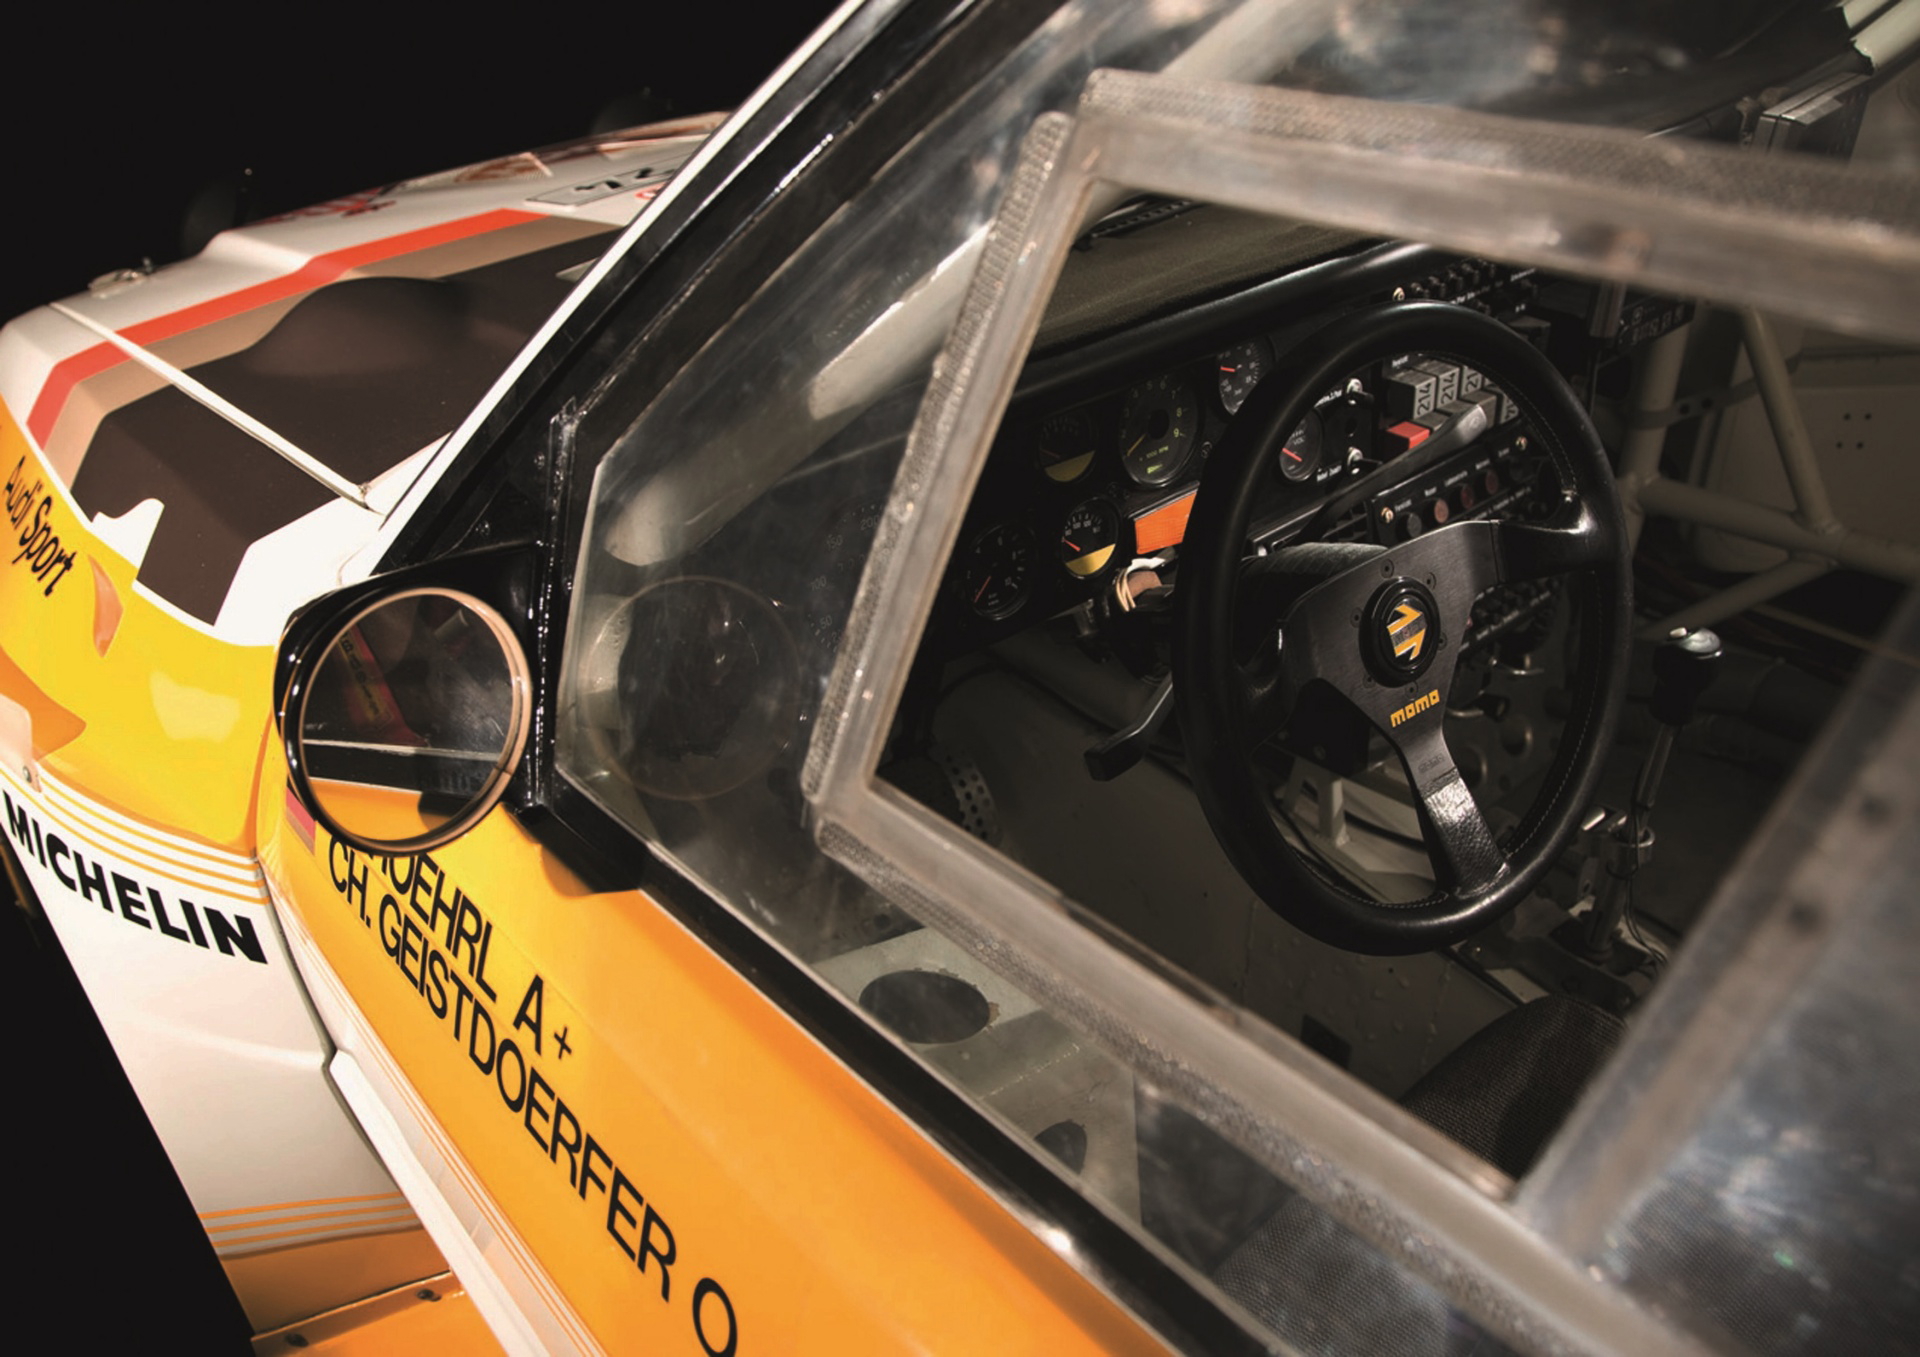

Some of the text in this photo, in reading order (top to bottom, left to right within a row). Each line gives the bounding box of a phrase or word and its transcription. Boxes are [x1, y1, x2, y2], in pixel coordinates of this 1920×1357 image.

[1417, 382, 1431, 416] 214
[1441, 373, 1456, 405] 214
[1466, 372, 1479, 392] 21
[3, 455, 77, 597] Audi Sport
[1390, 689, 1440, 728] momo
[3, 789, 268, 965] MICHELIN
[328, 835, 371, 929] CH.
[379, 893, 676, 1303] GEISTDOERFER
